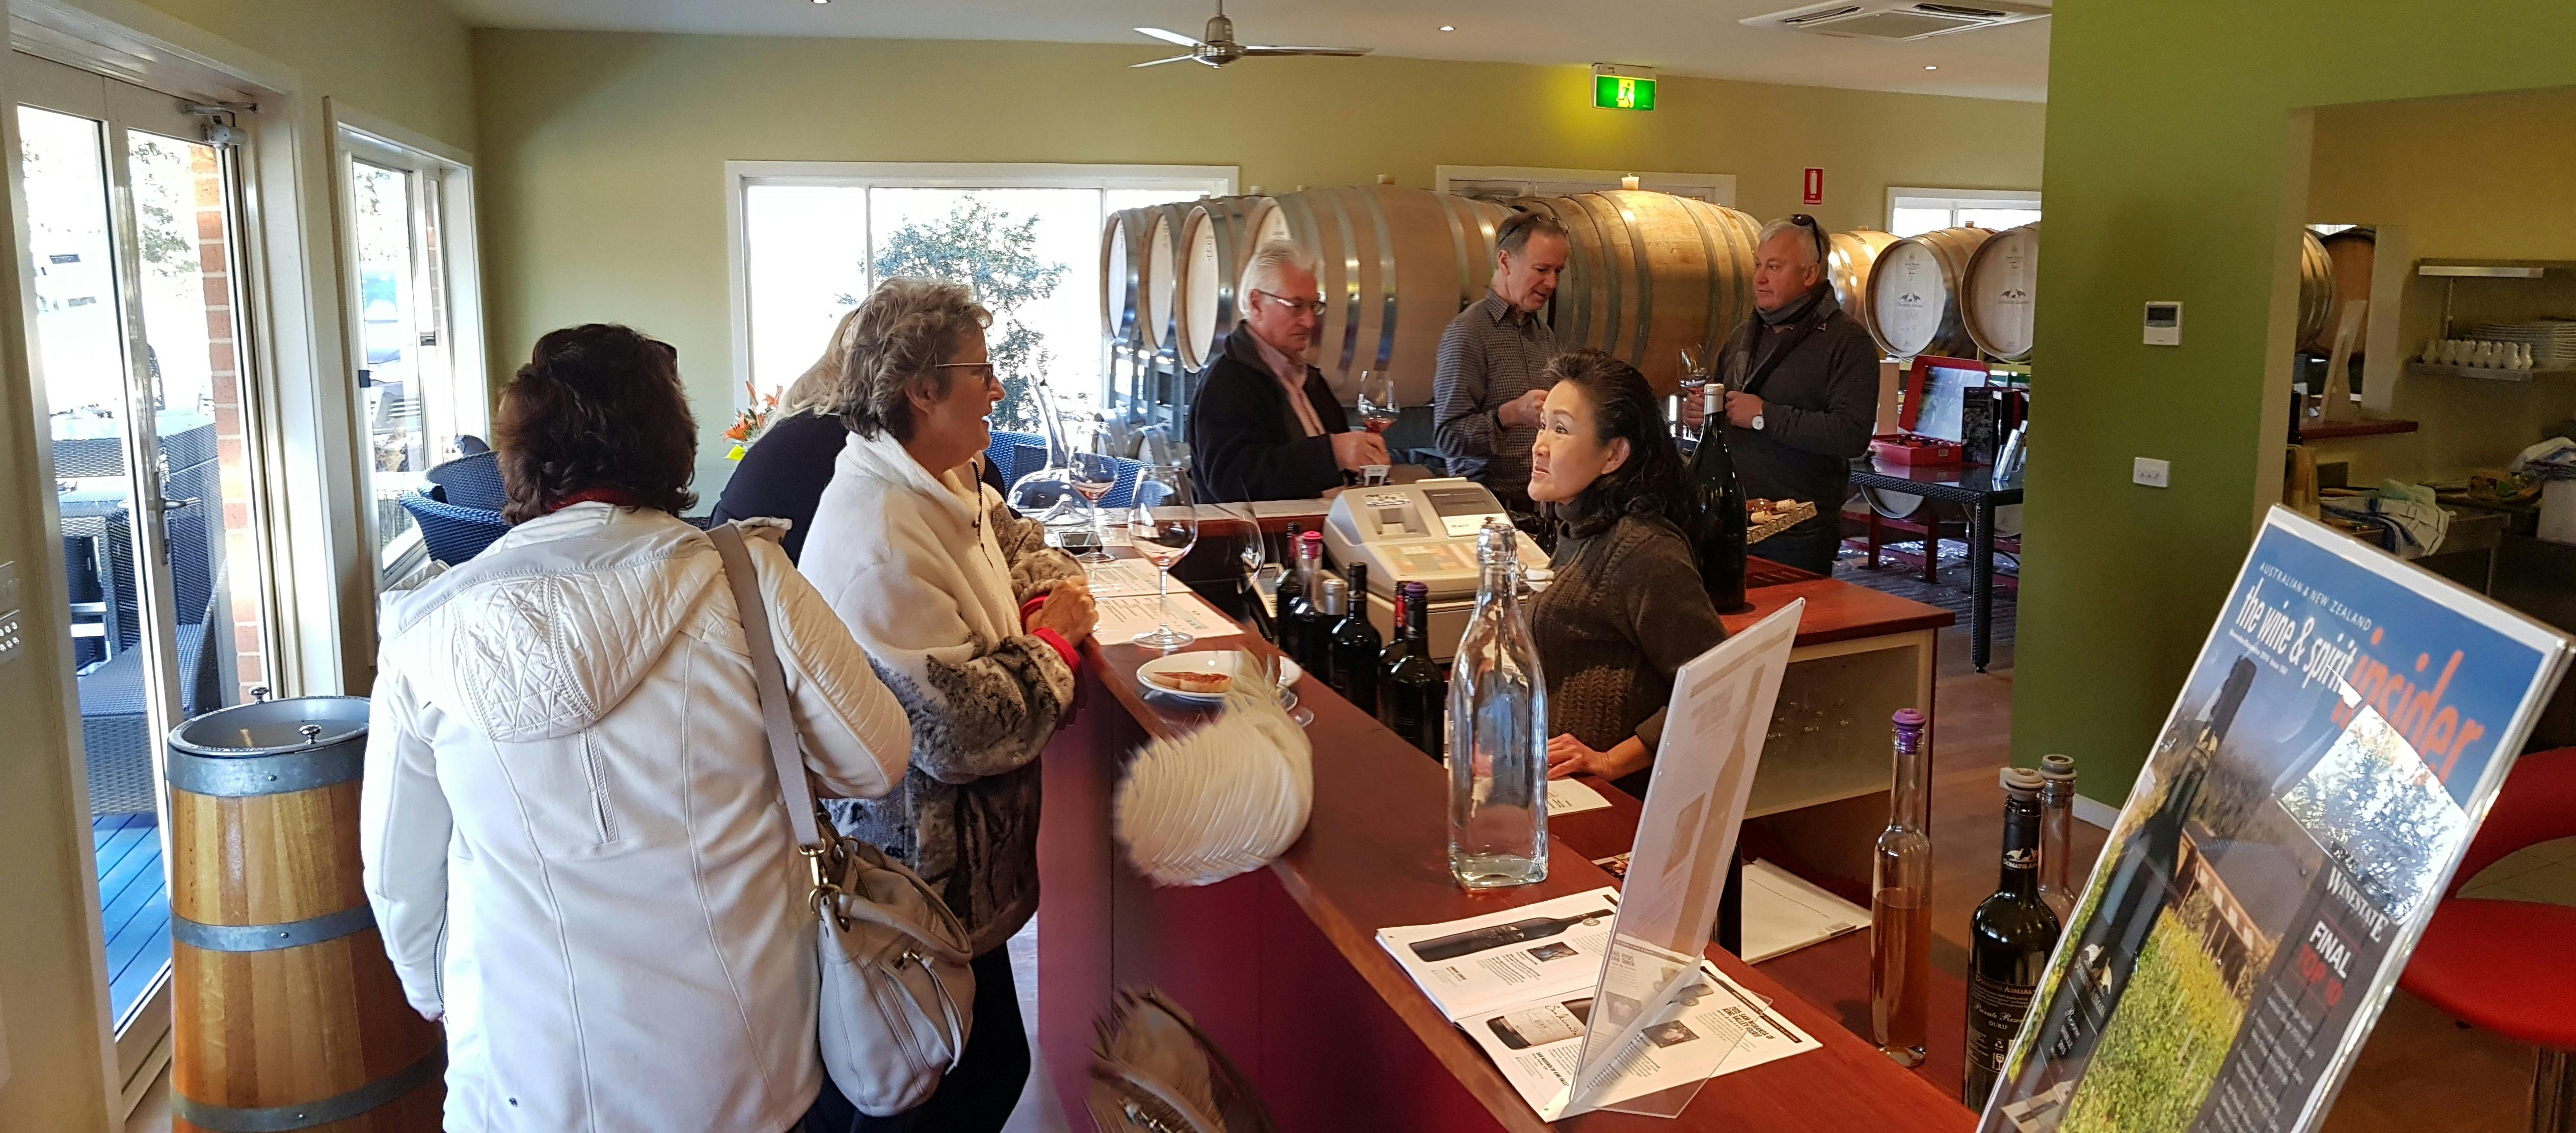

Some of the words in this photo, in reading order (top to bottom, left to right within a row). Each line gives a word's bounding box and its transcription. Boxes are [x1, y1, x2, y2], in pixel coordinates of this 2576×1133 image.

[2235, 577, 2266, 633] the
[2259, 562, 2303, 593] AUSTRALIAN
[2303, 586, 2310, 597] &
[2310, 589, 2330, 607] NEW
[2329, 600, 2372, 631] ZEALAND
[2257, 600, 2296, 655] wine
[2288, 616, 2315, 666] &
[2301, 633, 2358, 692] spirit
[2330, 627, 2485, 784] insider
[2326, 866, 2390, 942] WINESTATE
[2297, 943, 2327, 983] TOP
[2309, 920, 2351, 979] FINAL
[2004, 986, 2032, 995] ASMARA
[1722, 1008, 1734, 1016] KING
[1732, 1015, 1749, 1028] VALLEY
[1739, 1013, 1751, 1021] SAM
[1989, 1020, 2008, 1030] DURIF
[1999, 1012, 2022, 1023] Reser
